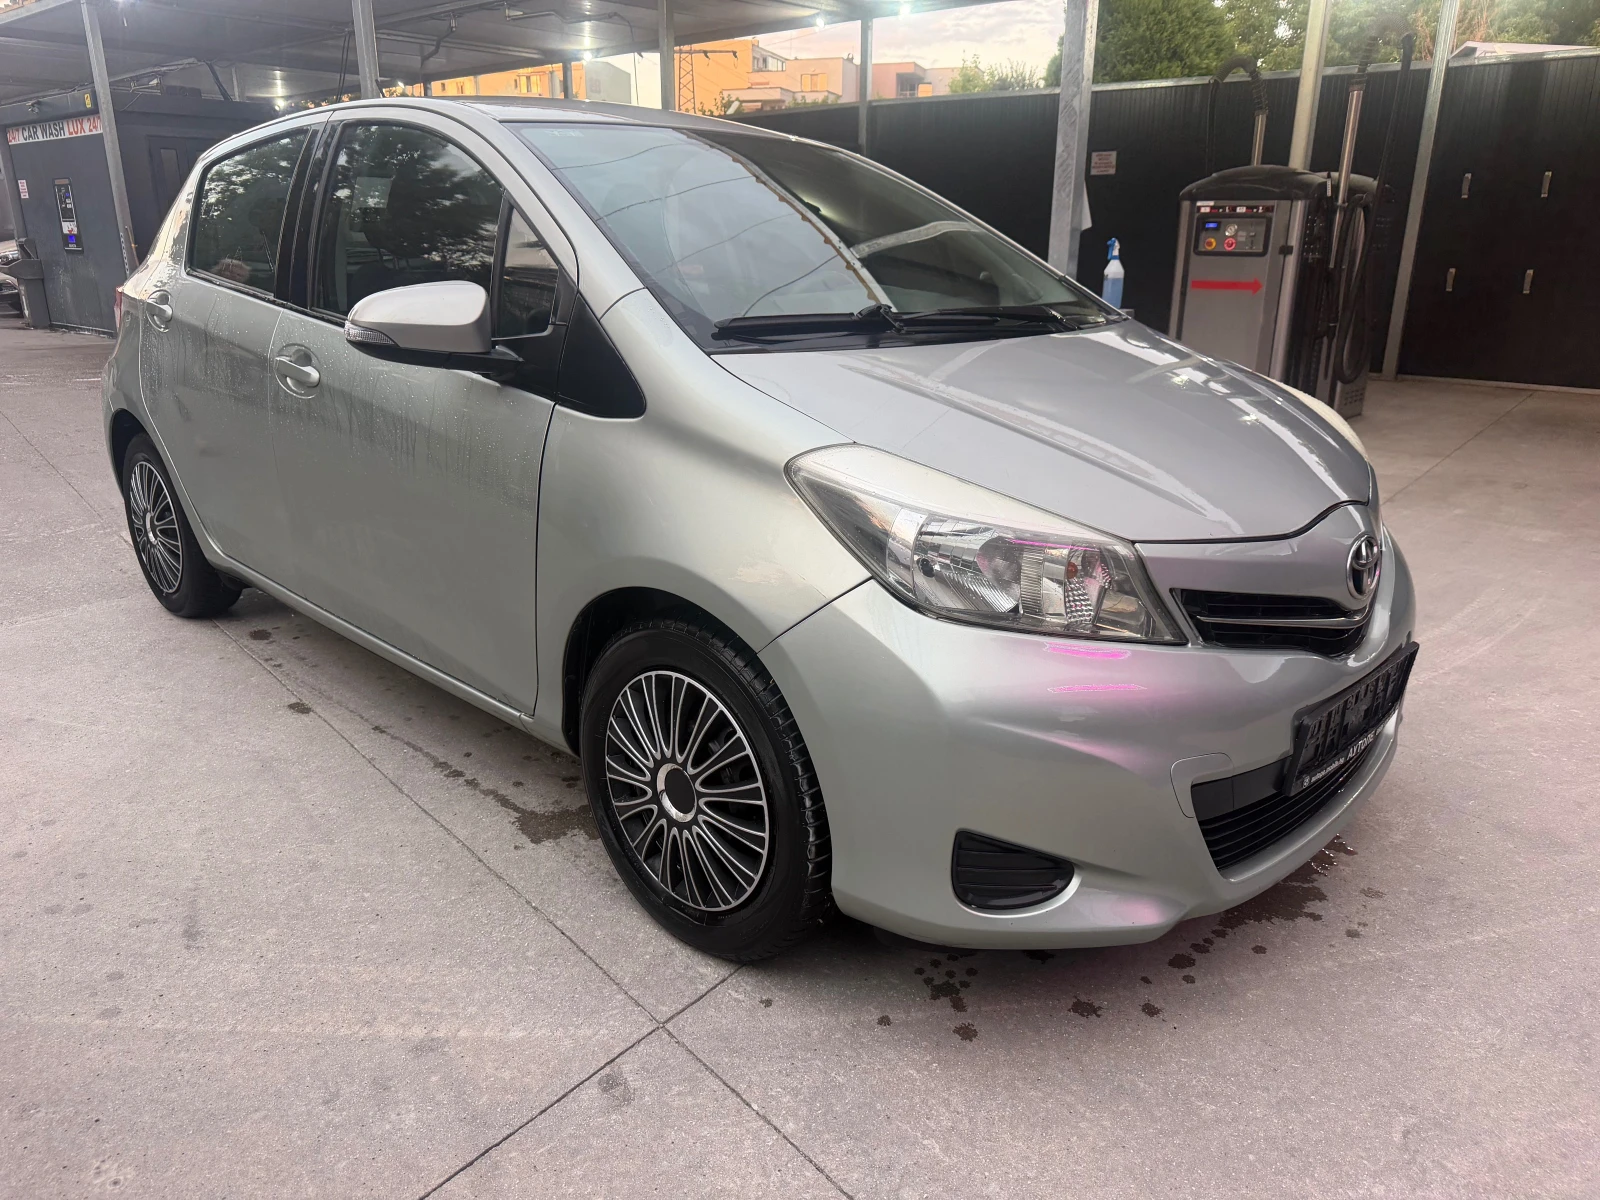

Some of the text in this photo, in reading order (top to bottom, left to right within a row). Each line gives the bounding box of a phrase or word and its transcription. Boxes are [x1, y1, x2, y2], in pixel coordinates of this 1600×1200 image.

[8, 115, 102, 143] 24/7 CAR WASH LUX 24/7
